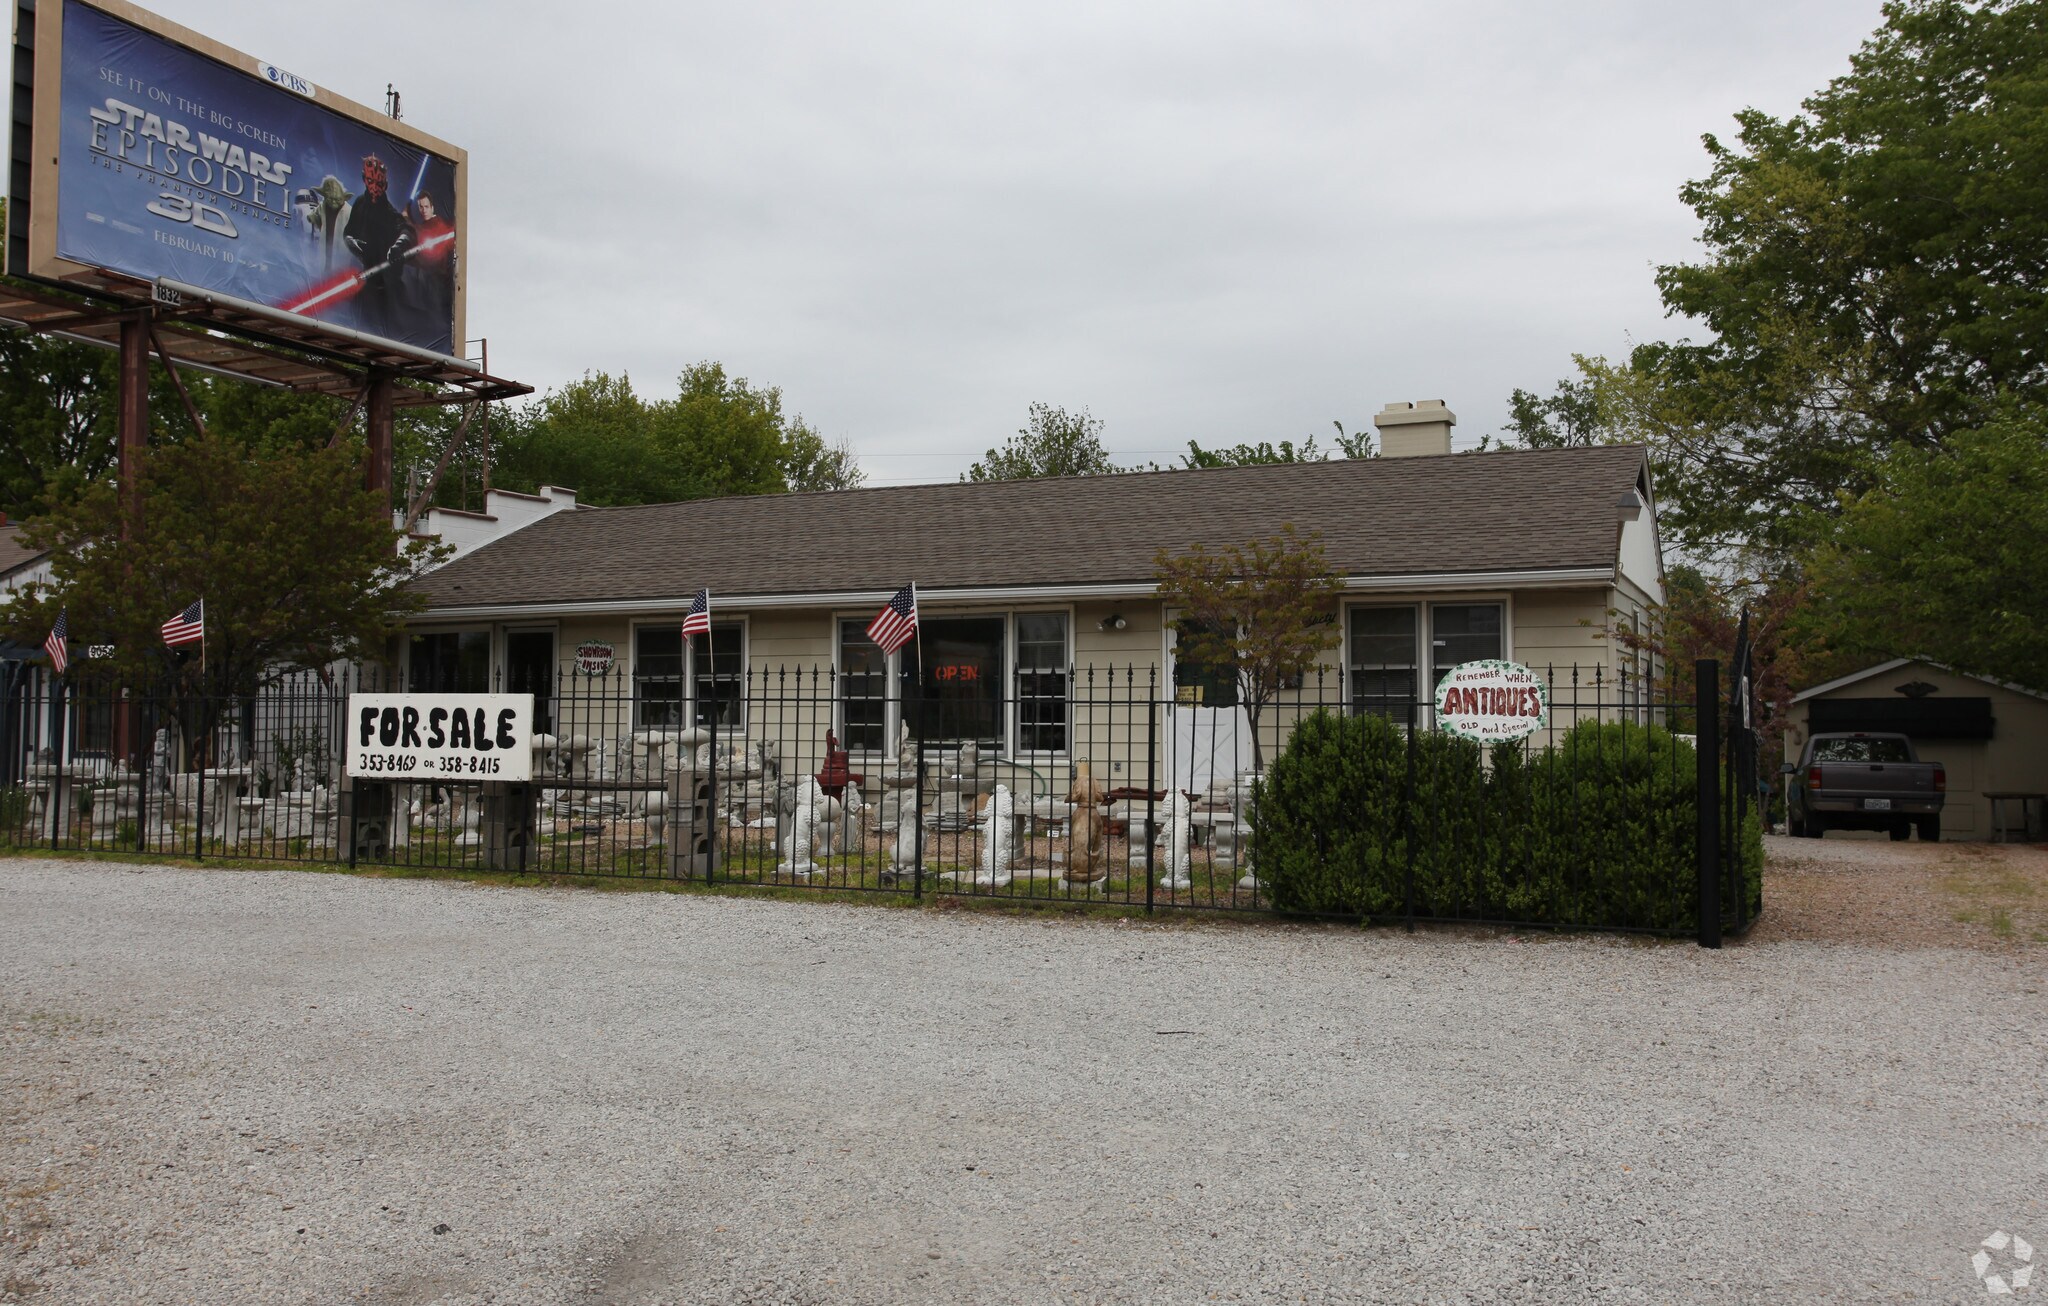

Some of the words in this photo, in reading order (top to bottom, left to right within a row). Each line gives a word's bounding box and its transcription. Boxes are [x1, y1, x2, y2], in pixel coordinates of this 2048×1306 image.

[280, 72, 308, 95] CBS
[100, 66, 123, 86] SEE
[129, 77, 145, 95] IT
[149, 86, 171, 106] ON
[176, 96, 205, 120] THE
[211, 110, 233, 130] BIG
[237, 121, 286, 150] SCREEN
[90, 98, 198, 155] STAR
[198, 131, 292, 186] WARS
[90, 118, 267, 207] EPISODE
[282, 188, 292, 216] I
[90, 155, 122, 174] THE
[137, 171, 218, 205] PHANTOM
[230, 203, 290, 229] MENACE
[146, 192, 239, 239] 3D
[154, 230, 220, 260] FEBRUARY
[222, 249, 235, 264] 10
[157, 284, 180, 304] 1832
[576, 646, 613, 659] SHOWROOM
[582, 659, 608, 671] INSIDE
[935, 665, 979, 681] OPEN
[1456, 670, 1502, 682] REMEMBER
[1504, 674, 1533, 684] WHEN
[1443, 686, 1541, 718] ANTIQUES
[360, 706, 422, 748] FOR
[427, 707, 516, 751] SALE
[1461, 721, 1480, 730] OLD
[359, 753, 417, 772] 353-8469
[439, 756, 501, 774] 358-8415
